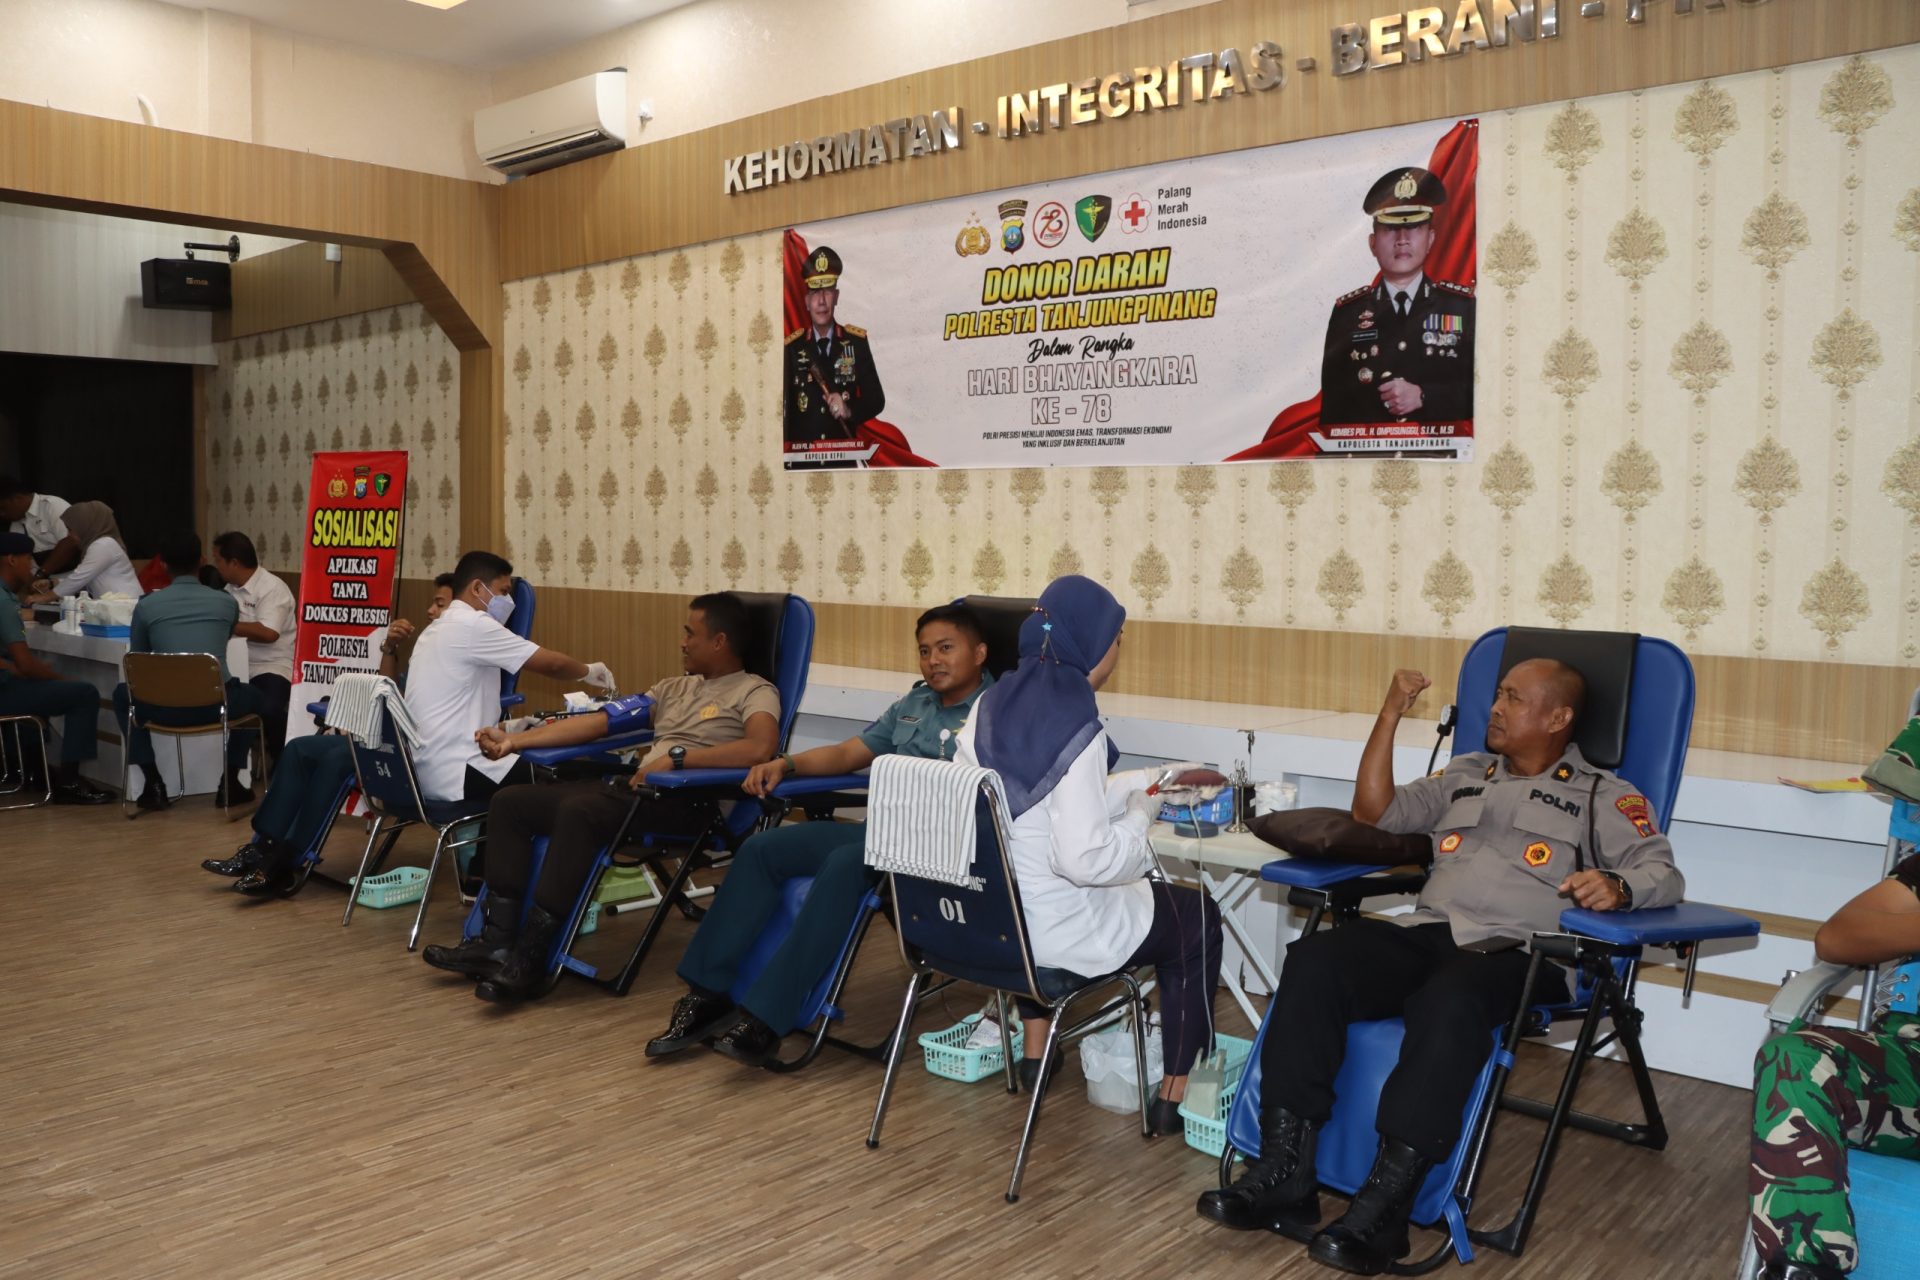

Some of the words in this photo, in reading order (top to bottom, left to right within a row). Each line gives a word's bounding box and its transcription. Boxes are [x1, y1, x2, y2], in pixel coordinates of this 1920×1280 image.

[723, 106, 964, 195] KEHORMATAN
[996, 41, 1285, 139] INTEGRITAS
[1330, 0, 1560, 77] BERANI
[1157, 186, 1192, 199] Palang
[1158, 202, 1189, 216] Merah
[1157, 215, 1207, 231] Indonesia
[982, 259, 1072, 305] DONOR
[1073, 247, 1171, 295] DARAH
[943, 305, 1037, 340] POLRESTA
[1041, 288, 1218, 333] TANJUNGPINANG
[1027, 336, 1073, 363] Dalam
[1079, 332, 1135, 360] Rangka
[967, 366, 1018, 396] HARI
[1023, 355, 1198, 392] BHAYANGKARA
[1083, 394, 1112, 423] 78
[982, 432, 999, 440] POLRI
[999, 431, 1020, 439] PRESISI
[1021, 430, 1044, 438] MENUJU
[1045, 429, 1075, 437] INDONESIA
[1095, 427, 1142, 436] TRANSFORMASI
[1143, 426, 1172, 434] EKONOMI
[1022, 440, 1037, 448] YANG
[1037, 439, 1063, 448] INKLUSIF
[1063, 439, 1075, 447] DAN
[1075, 438, 1126, 447] BERKELANJUTAN
[1385, 439, 1450, 448] TANJUNGPINANG
[311, 508, 399, 549] SOSIALISASI
[327, 557, 377, 575] APLIKASI
[331, 581, 368, 600] TANYA
[304, 604, 349, 623] DOKKES
[349, 606, 390, 626] PRESISI
[319, 636, 369, 658] POLRESTA
[1529, 788, 1581, 818] POLRI
